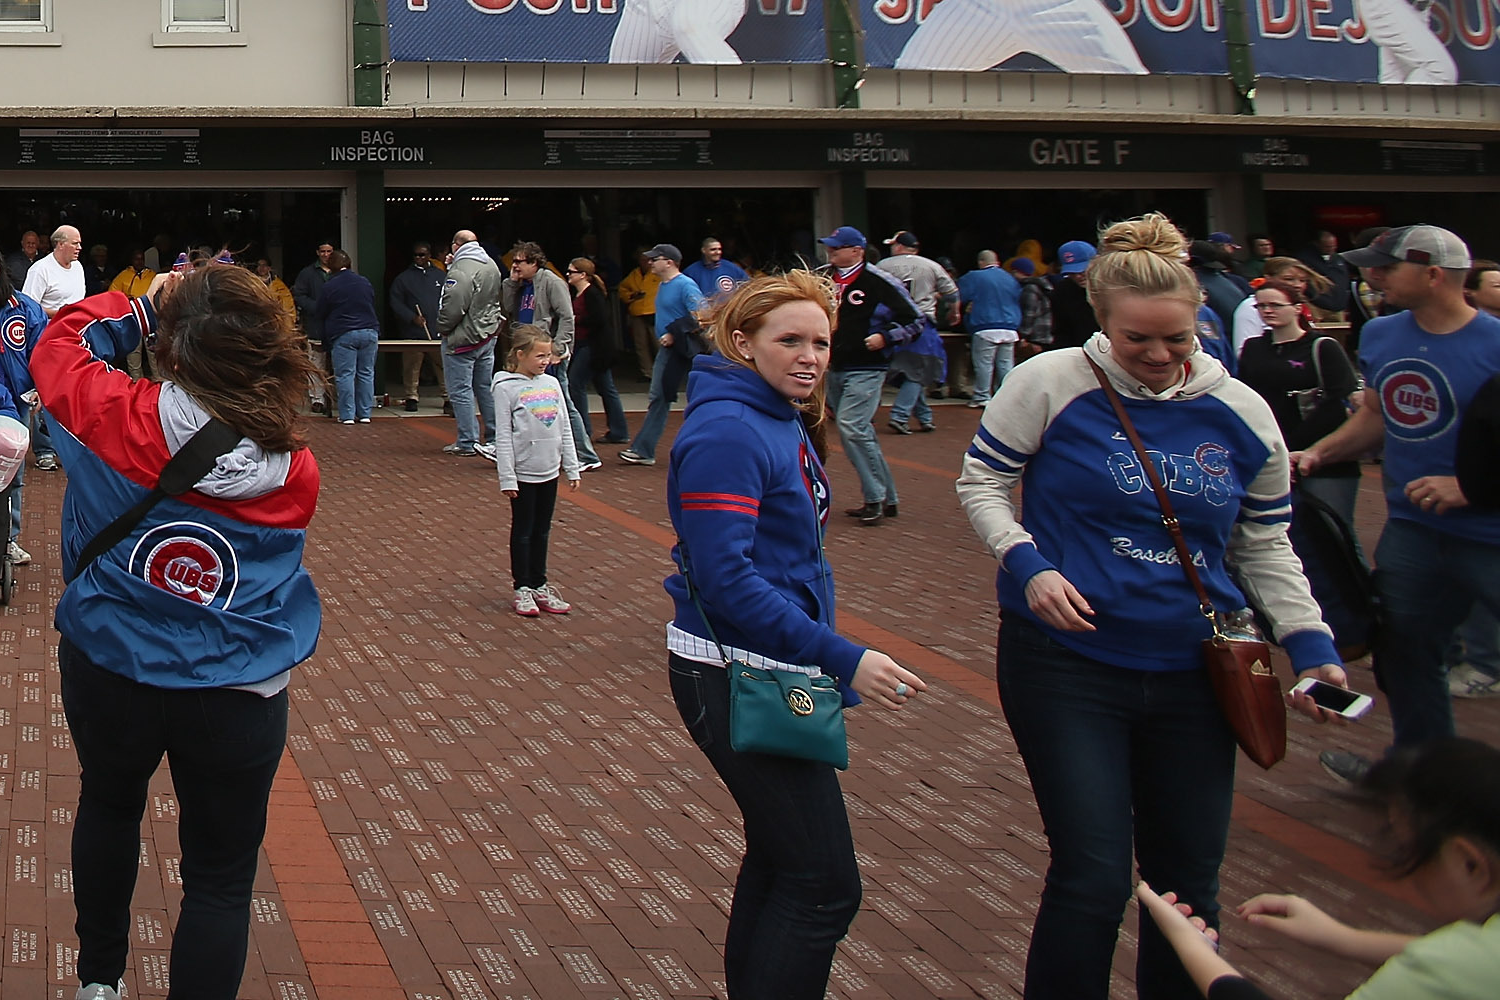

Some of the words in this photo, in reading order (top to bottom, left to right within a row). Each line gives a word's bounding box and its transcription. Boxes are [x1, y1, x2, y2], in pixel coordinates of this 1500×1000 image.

[361, 131, 395, 145] BAG
[853, 133, 884, 146] BAG
[1263, 138, 1290, 152] BAG
[331, 147, 424, 161] INSPECTION
[827, 148, 910, 162] INSPECTION
[1029, 138, 1101, 165] GATE
[1113, 140, 1131, 164] F
[1242, 152, 1310, 167] INSPECTION
[1382, 370, 1440, 429] CUBS
[149, 540, 220, 606] CUBS
